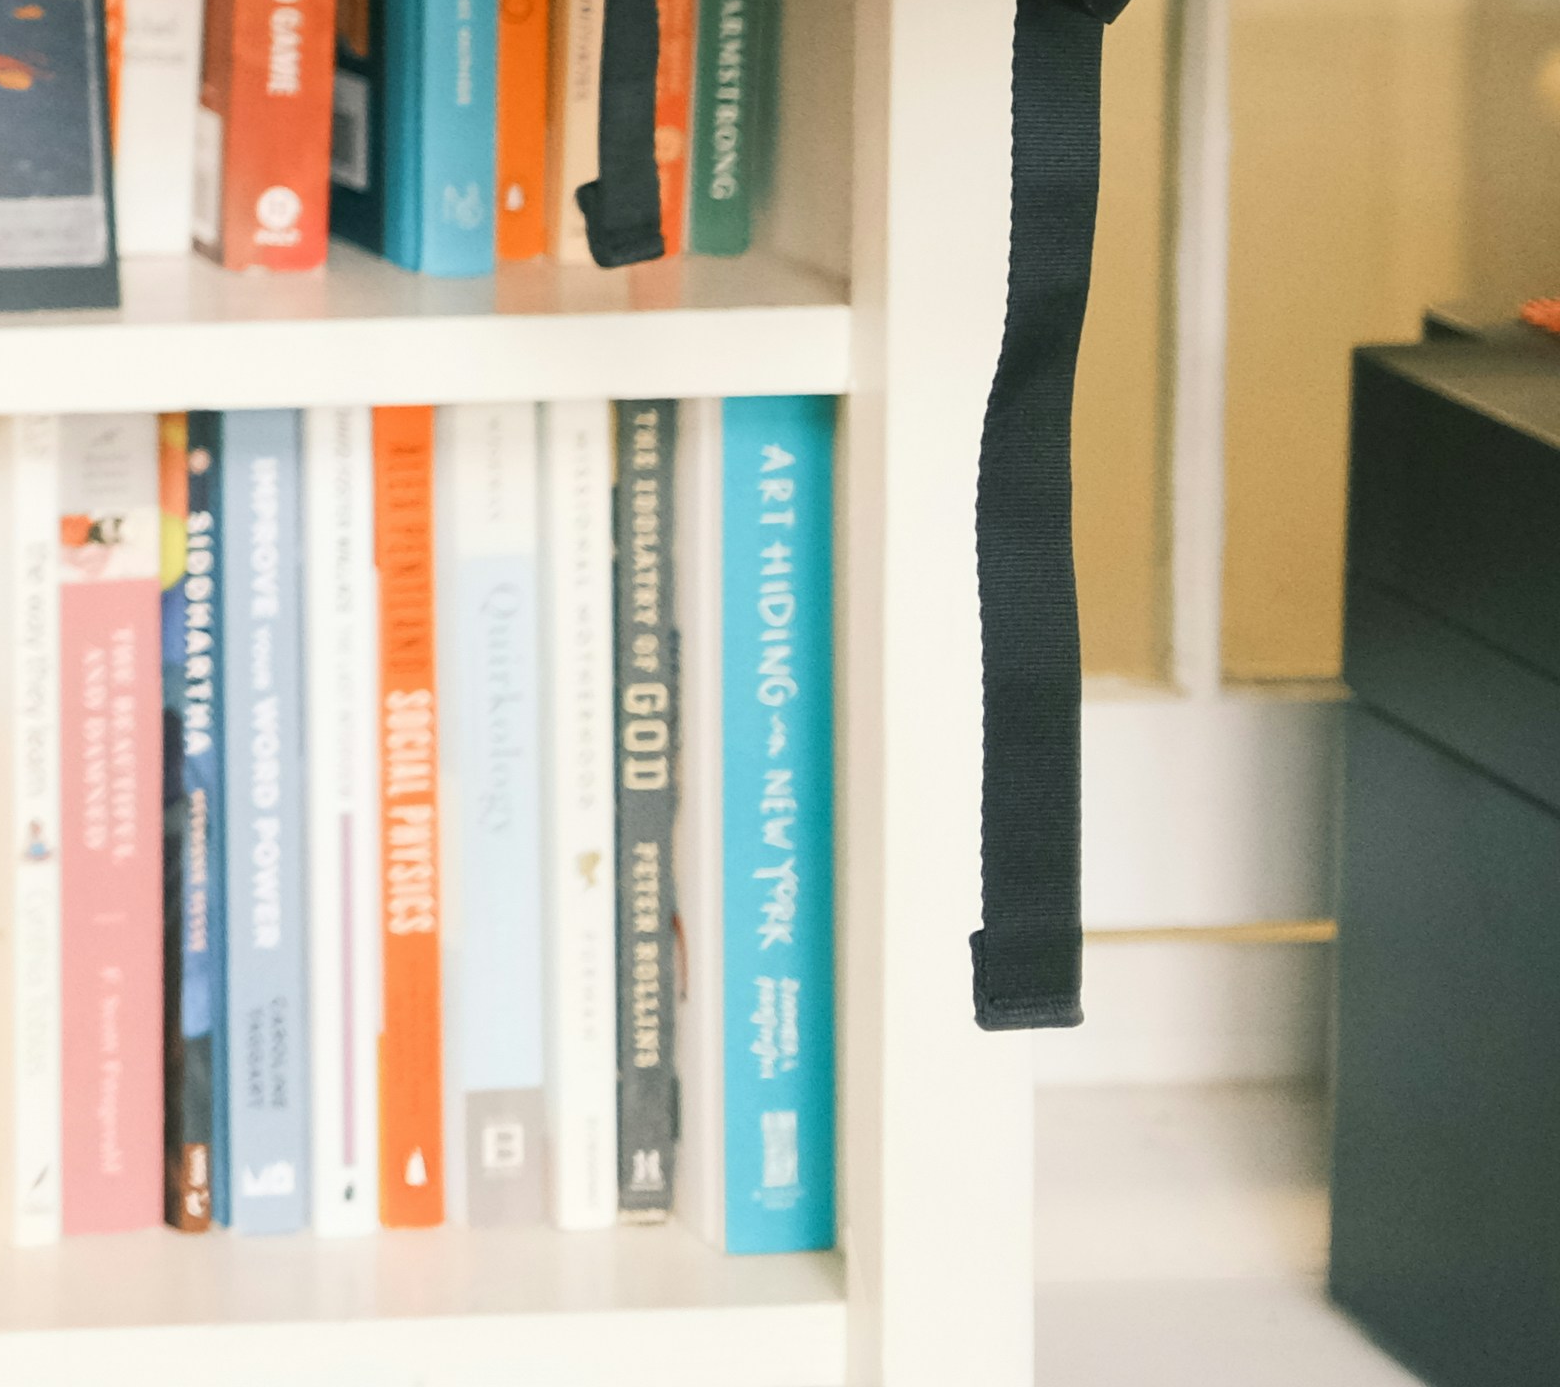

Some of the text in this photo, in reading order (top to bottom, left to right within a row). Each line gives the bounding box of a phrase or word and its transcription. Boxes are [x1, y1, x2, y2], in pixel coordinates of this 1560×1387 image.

[184, 512, 212, 755] SIDDHARTHA
[623, 410, 668, 790] THE IDOLATRY OF GOD
[759, 446, 795, 706] ART HIDING
[252, 458, 280, 947] IMPROVE WORD POWER
[386, 691, 434, 933] SOCIAL PHYSICS
[483, 583, 523, 837] Quirkology
[762, 770, 794, 846] NEW
[634, 843, 658, 1067] PETER ROLLINS
[756, 859, 797, 949] YORK
